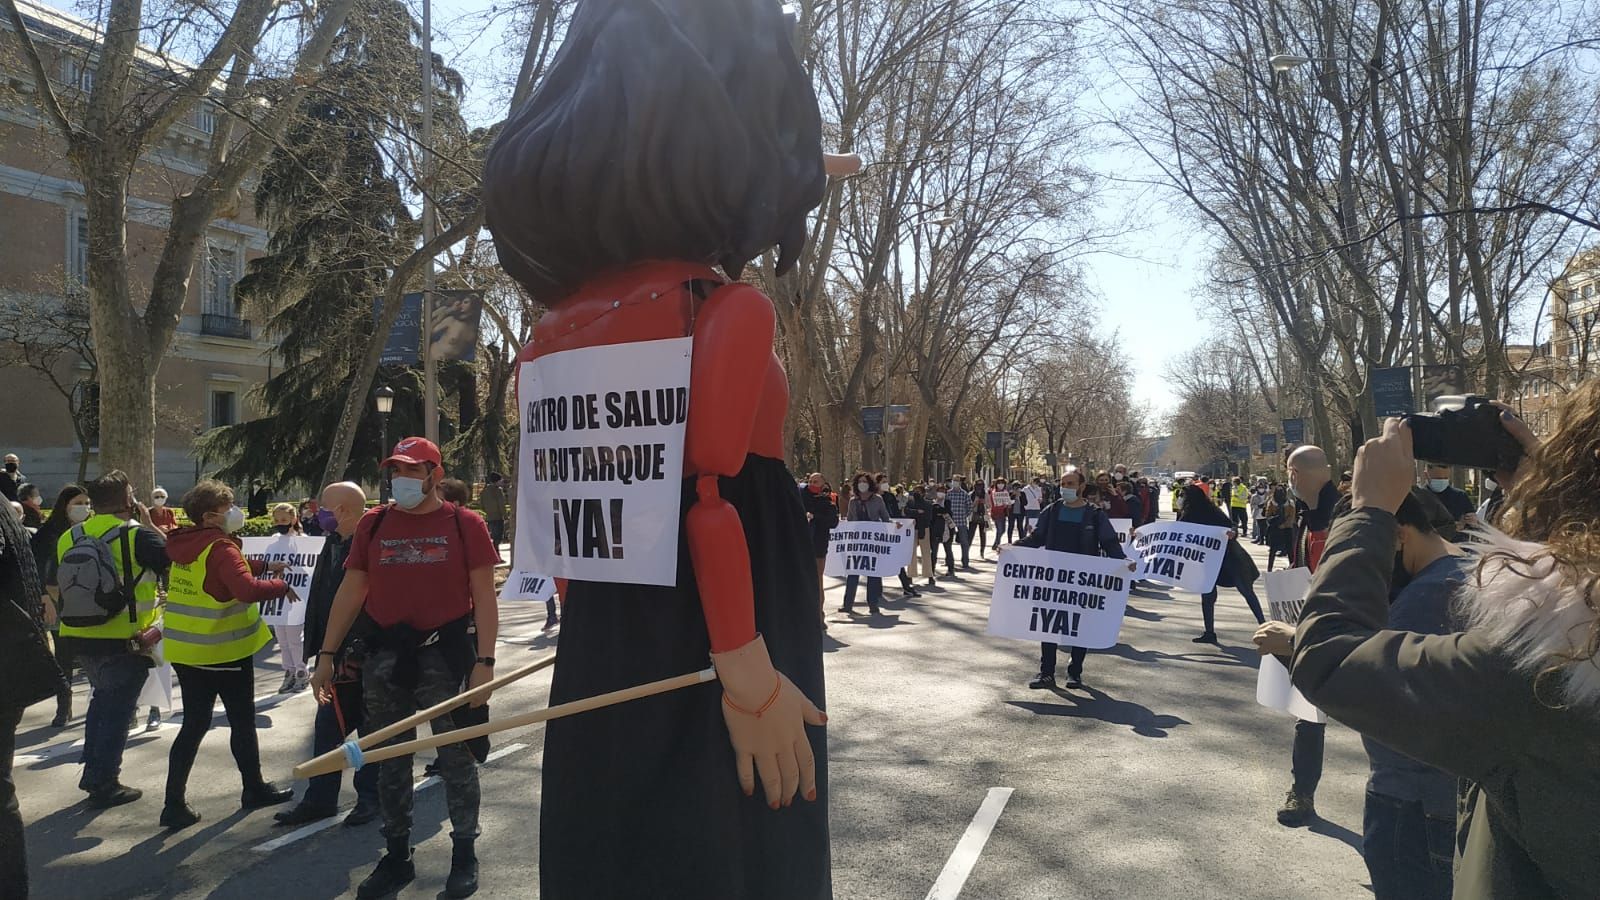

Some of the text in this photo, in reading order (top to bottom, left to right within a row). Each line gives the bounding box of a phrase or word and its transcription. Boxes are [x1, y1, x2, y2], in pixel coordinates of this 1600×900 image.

[527, 387, 688, 434] CENTRO DE SALUD
[534, 443, 666, 485] EN BUTARQUE
[552, 498, 624, 560] ¡YA!
[829, 531, 902, 544] CENTRO DE SALUD
[1136, 531, 1222, 551] CENTRO DE SALUD
[836, 543, 892, 555] EN BUTARQUE
[1139, 544, 1207, 564] EN BUTARQUE
[845, 555, 877, 572] ¡YA!
[1143, 557, 1185, 581] ¡YA!
[519, 576, 546, 595] ¡YA!
[1002, 562, 1124, 592] CENTRO DE SALUD
[1013, 584, 1107, 611] EN BUTARQUE
[1029, 607, 1082, 638] ¡YA!
